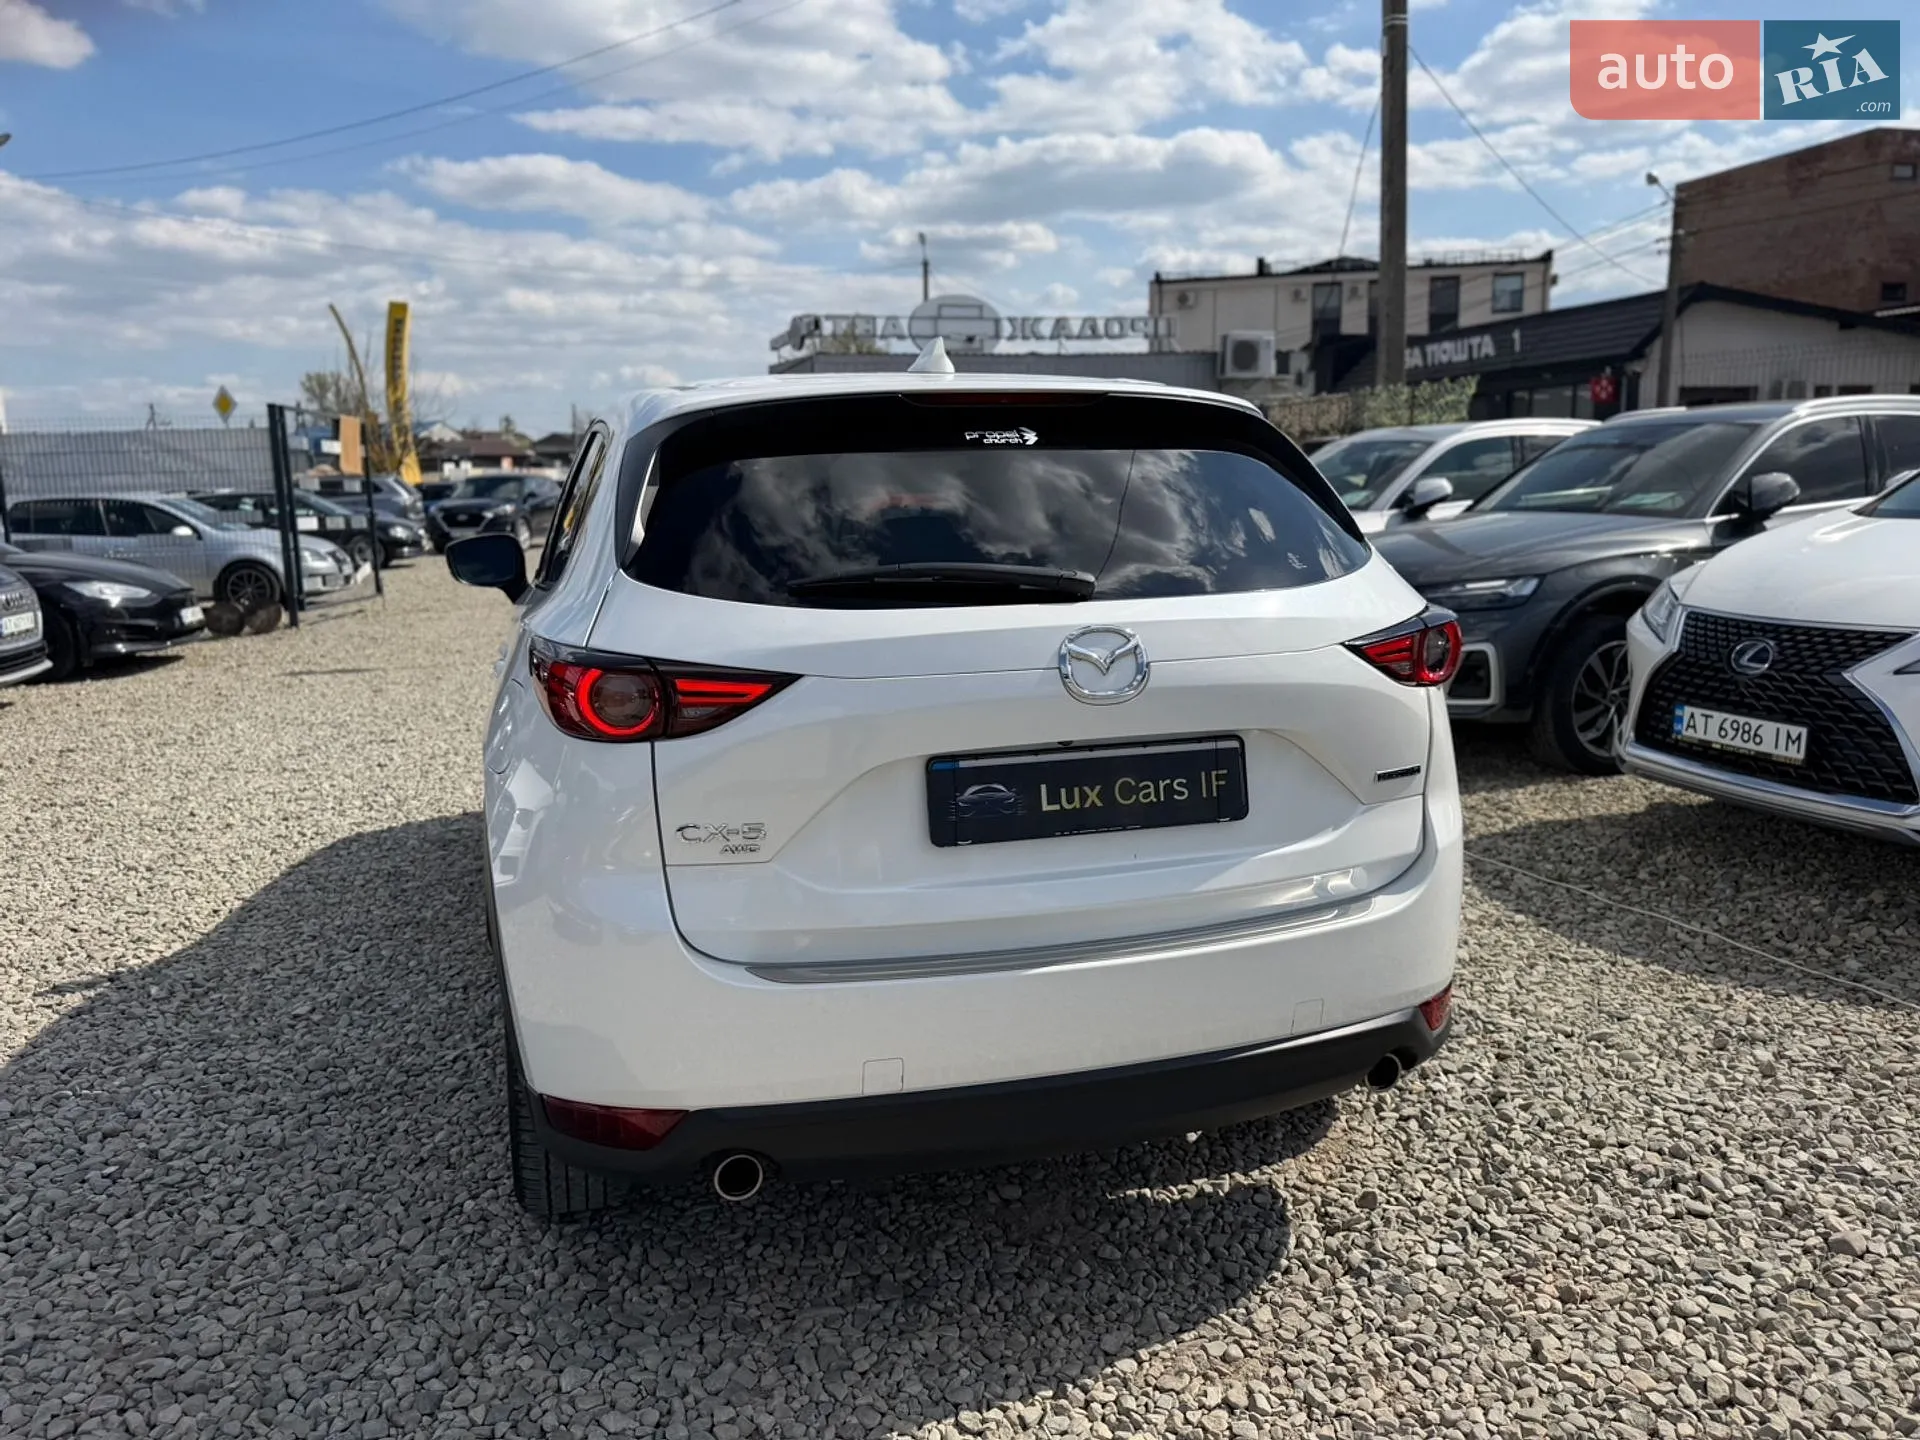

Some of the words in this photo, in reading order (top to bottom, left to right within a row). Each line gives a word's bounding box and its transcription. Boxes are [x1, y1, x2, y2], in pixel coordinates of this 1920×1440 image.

[1425, 334, 1496, 367] ПОШТА
[1512, 329, 1520, 352] 1
[1685, 711, 1714, 736] AT
[1717, 717, 1764, 746] 6986
[1774, 727, 1803, 754] IM
[1040, 783, 1103, 812] Lux
[1114, 777, 1189, 805] Cars
[1200, 769, 1229, 799] IF
[676, 822, 767, 842] CX-5
